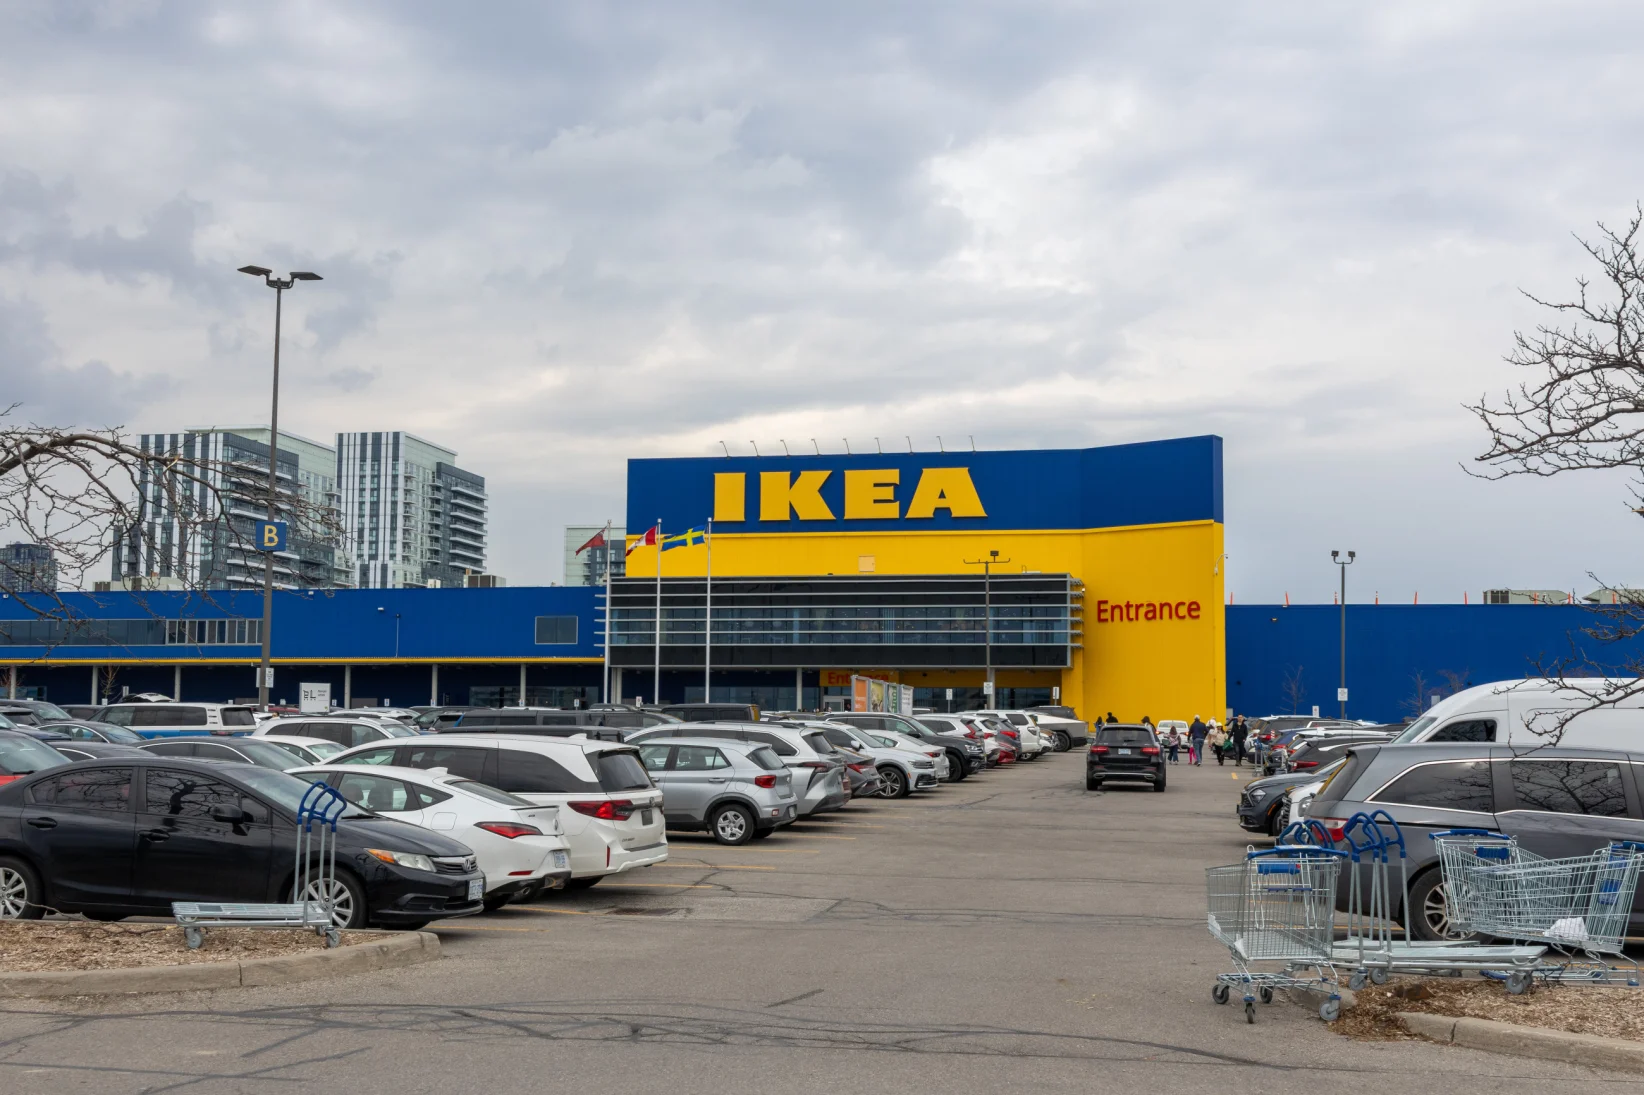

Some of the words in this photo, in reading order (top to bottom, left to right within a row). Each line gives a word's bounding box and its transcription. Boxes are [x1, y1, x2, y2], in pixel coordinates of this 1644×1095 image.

[714, 467, 987, 522] IKEA
[264, 524, 279, 547] B
[1097, 600, 1201, 623] Entrance
